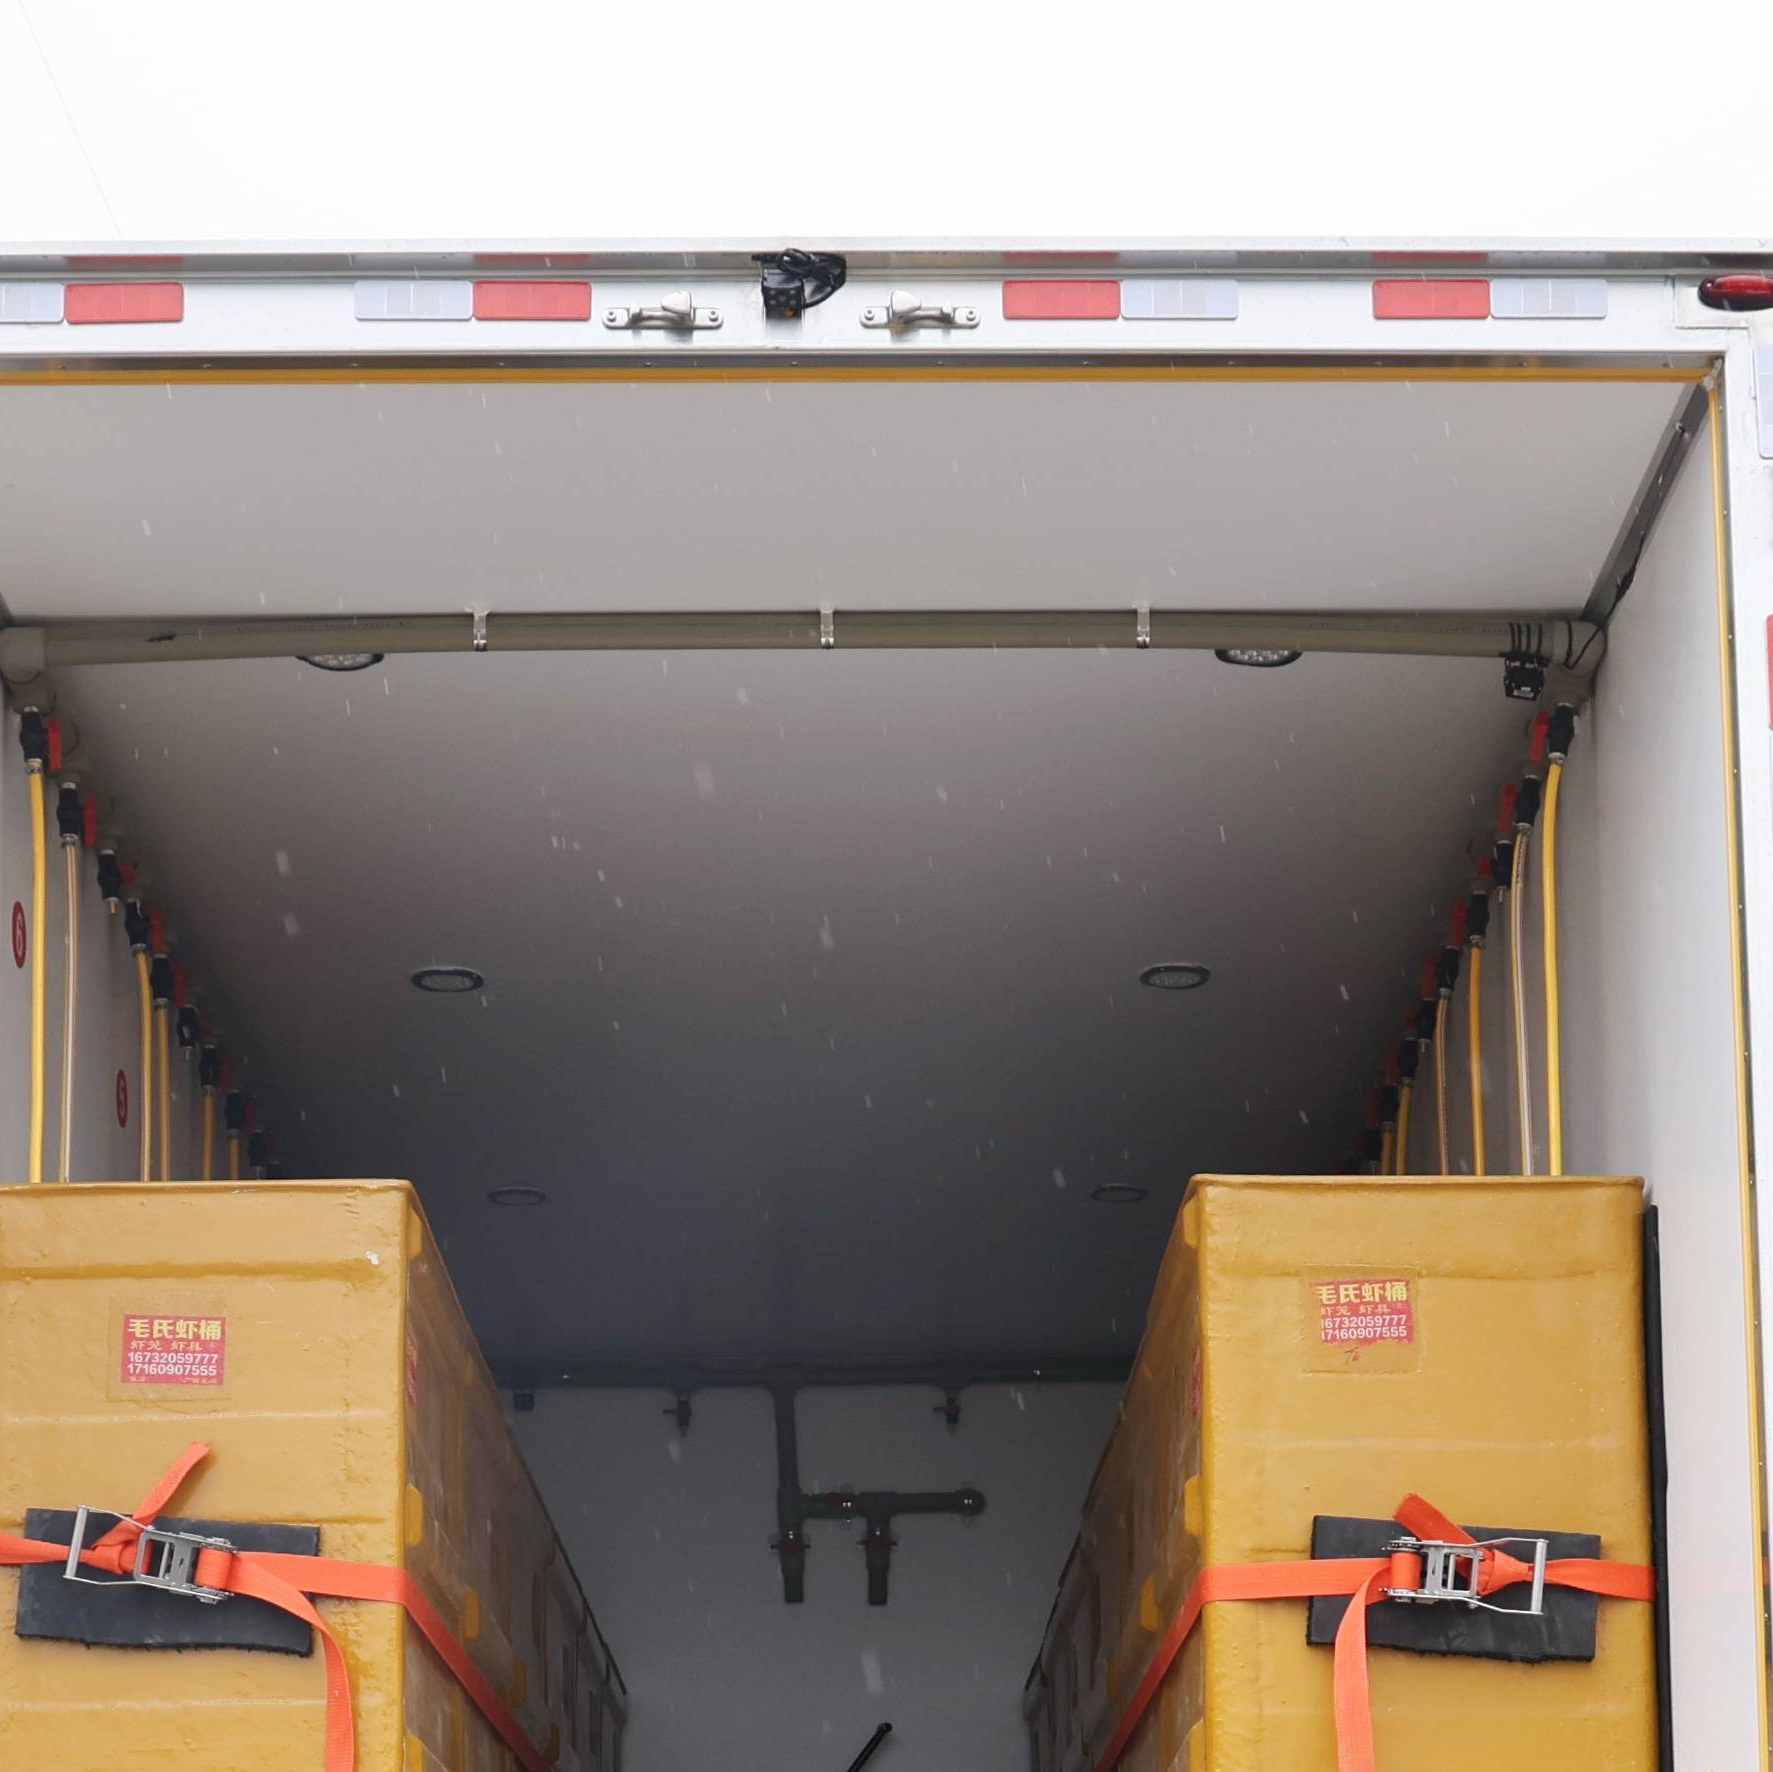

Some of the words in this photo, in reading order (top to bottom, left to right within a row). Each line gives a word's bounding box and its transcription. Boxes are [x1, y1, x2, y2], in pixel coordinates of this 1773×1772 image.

[16, 911, 25, 958] 6
[1316, 1282, 1407, 1304] 毛氏虾桶
[128, 1319, 222, 1340] 毛氏虾桶
[127, 1352, 218, 1364] 16732059777
[127, 1363, 217, 1376] 17160907555
